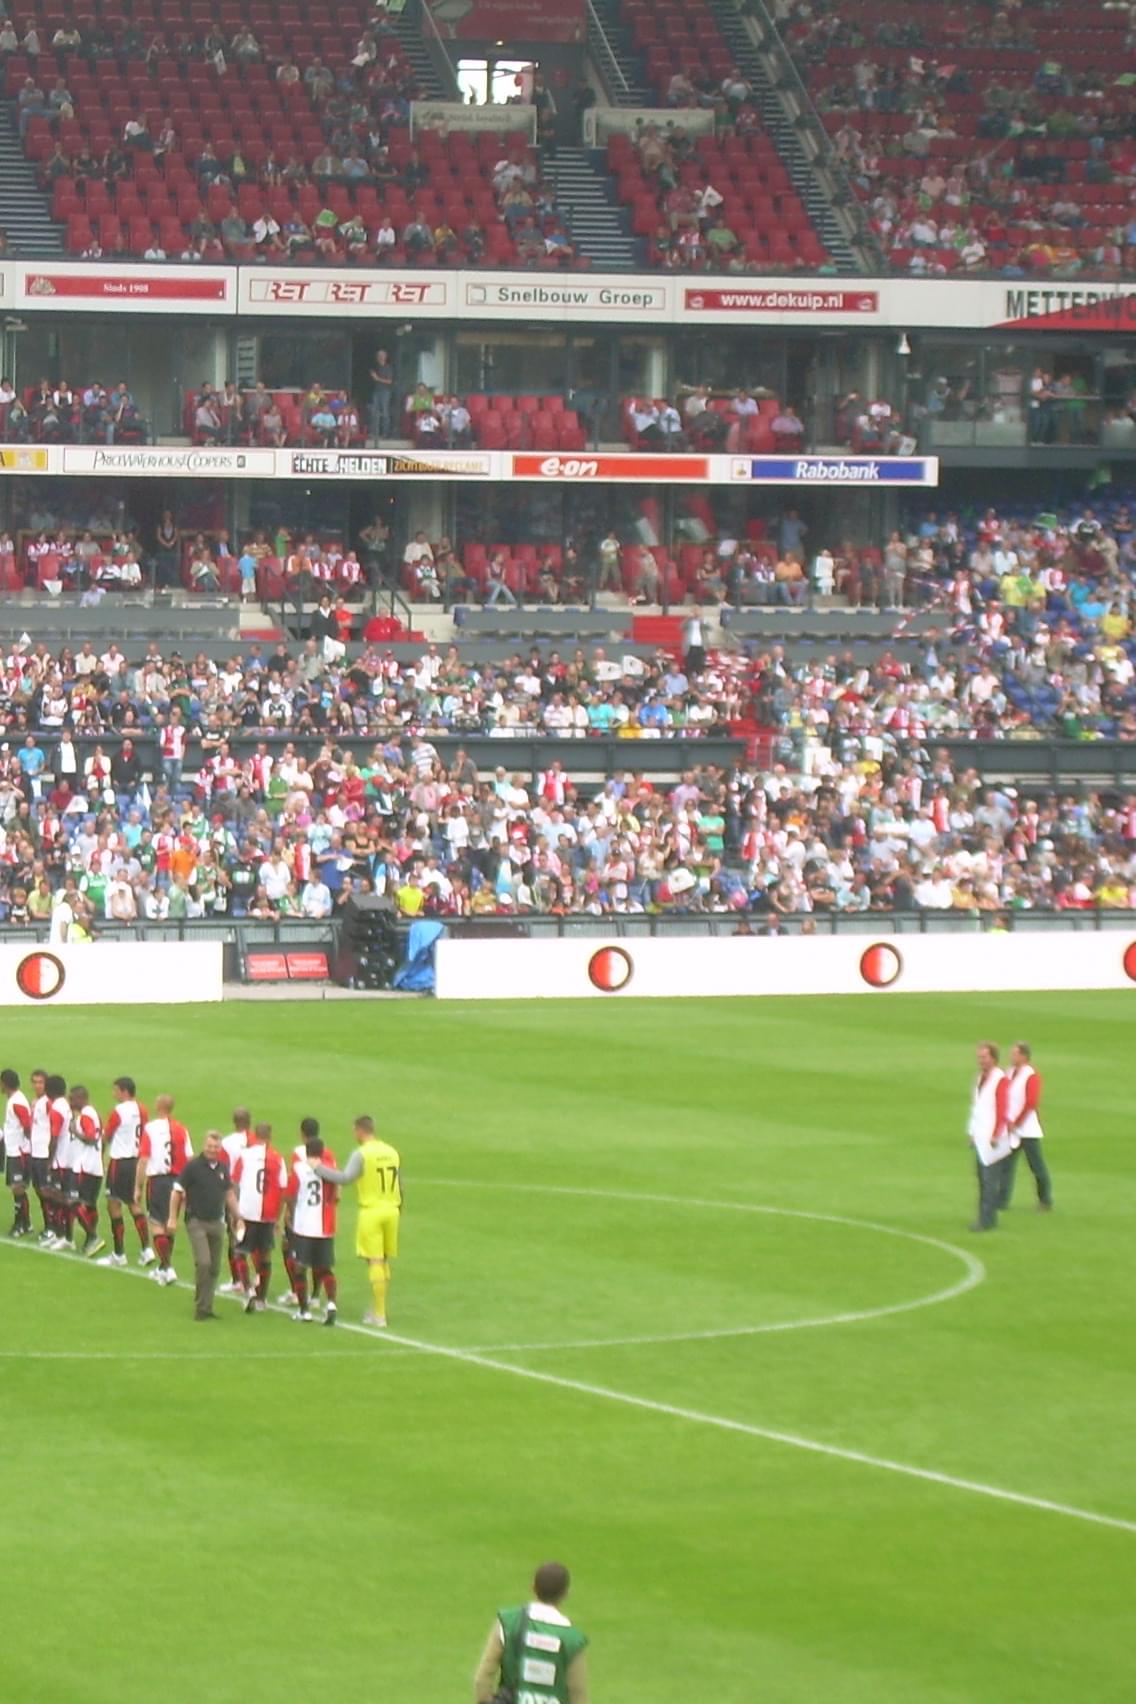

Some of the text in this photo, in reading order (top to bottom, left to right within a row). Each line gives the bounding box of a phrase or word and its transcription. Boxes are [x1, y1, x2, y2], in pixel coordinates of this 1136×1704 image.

[270, 282, 310, 301] RET
[331, 283, 371, 302] RET
[391, 284, 431, 303] RET
[498, 287, 654, 309] Snelbouw Groep
[720, 291, 844, 310] www.dekuip.nl
[294, 456, 329, 473] ECHTE
[795, 461, 879, 480] Rabobank
[376, 1166, 397, 1193] 17
[307, 1180, 321, 1206] 3
